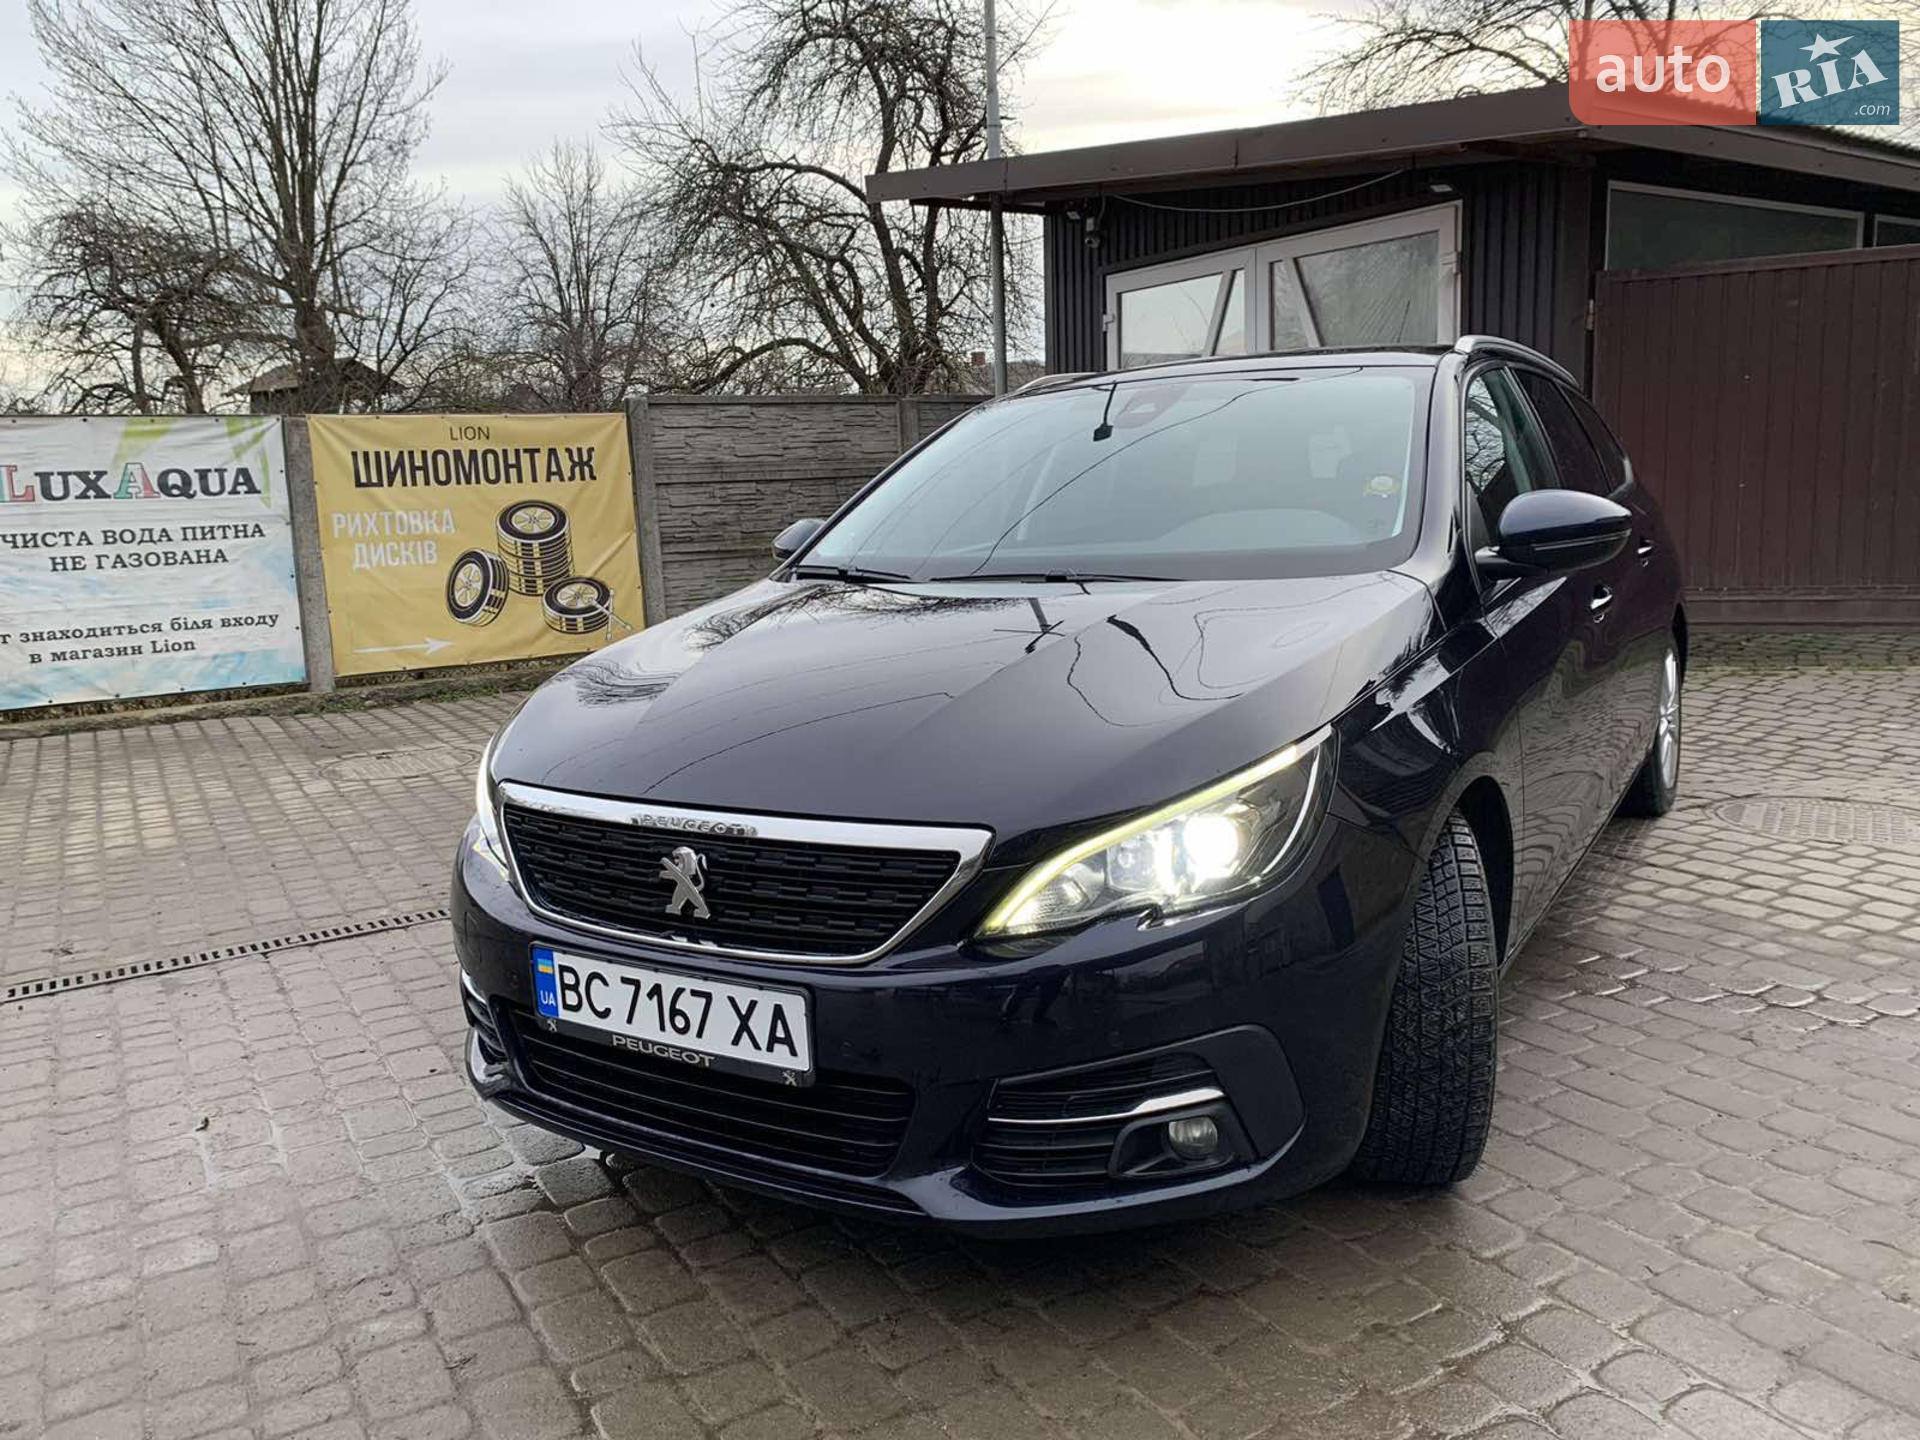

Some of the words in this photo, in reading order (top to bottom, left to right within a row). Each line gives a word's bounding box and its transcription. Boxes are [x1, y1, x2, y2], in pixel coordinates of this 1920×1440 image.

[450, 426, 491, 441] LION
[351, 446, 597, 488] ШИНОМОНТАЖ
[0, 530, 93, 549] ЧИСТА
[101, 527, 174, 546] ВОДА
[181, 523, 266, 542] ПИТНА
[331, 508, 456, 538] РИХТОВКА
[49, 556, 86, 572] НЕ
[95, 549, 229, 570] ГАЗОВАНА
[352, 541, 438, 570] ДИСКІВ
[19, 622, 163, 644] знаходиться
[170, 617, 213, 632] біля
[220, 613, 280, 629] входу
[29, 653, 43, 664] в
[51, 645, 143, 662] магазин
[151, 639, 196, 654] Lion
[641, 814, 743, 835] PEUGEOT
[540, 989, 557, 1008] UA
[557, 964, 612, 1020] BC
[620, 976, 713, 1039] 7167
[726, 995, 798, 1058] XA
[612, 1034, 715, 1068] PEUGEOT
